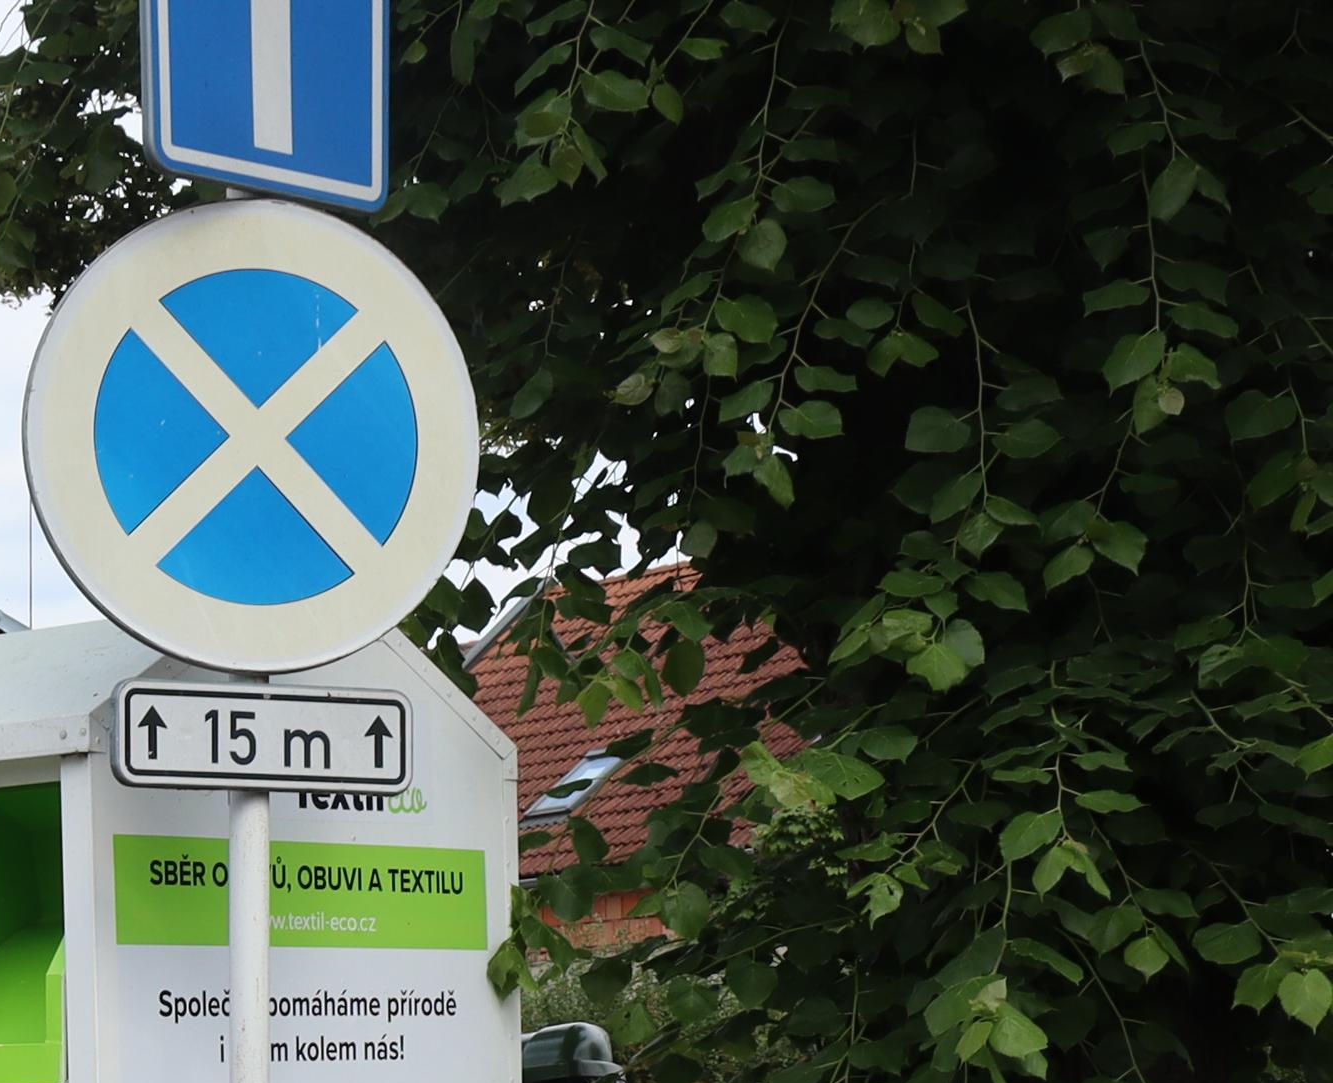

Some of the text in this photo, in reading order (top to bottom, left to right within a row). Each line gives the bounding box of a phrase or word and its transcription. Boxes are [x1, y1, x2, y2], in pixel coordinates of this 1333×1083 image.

[204, 709, 331, 770] 15 m
[149, 854, 206, 887] SBĚR
[297, 864, 362, 892] OBUVI
[368, 868, 383, 892] A
[388, 868, 464, 895] TEXTILU
[269, 911, 377, 934] w.textil-eco.cz
[158, 988, 231, 1024] Společ
[387, 989, 457, 1023] přírodě
[219, 1035, 225, 1063] i
[295, 1035, 357, 1063] kolem
[364, 1033, 405, 1061] nás!
